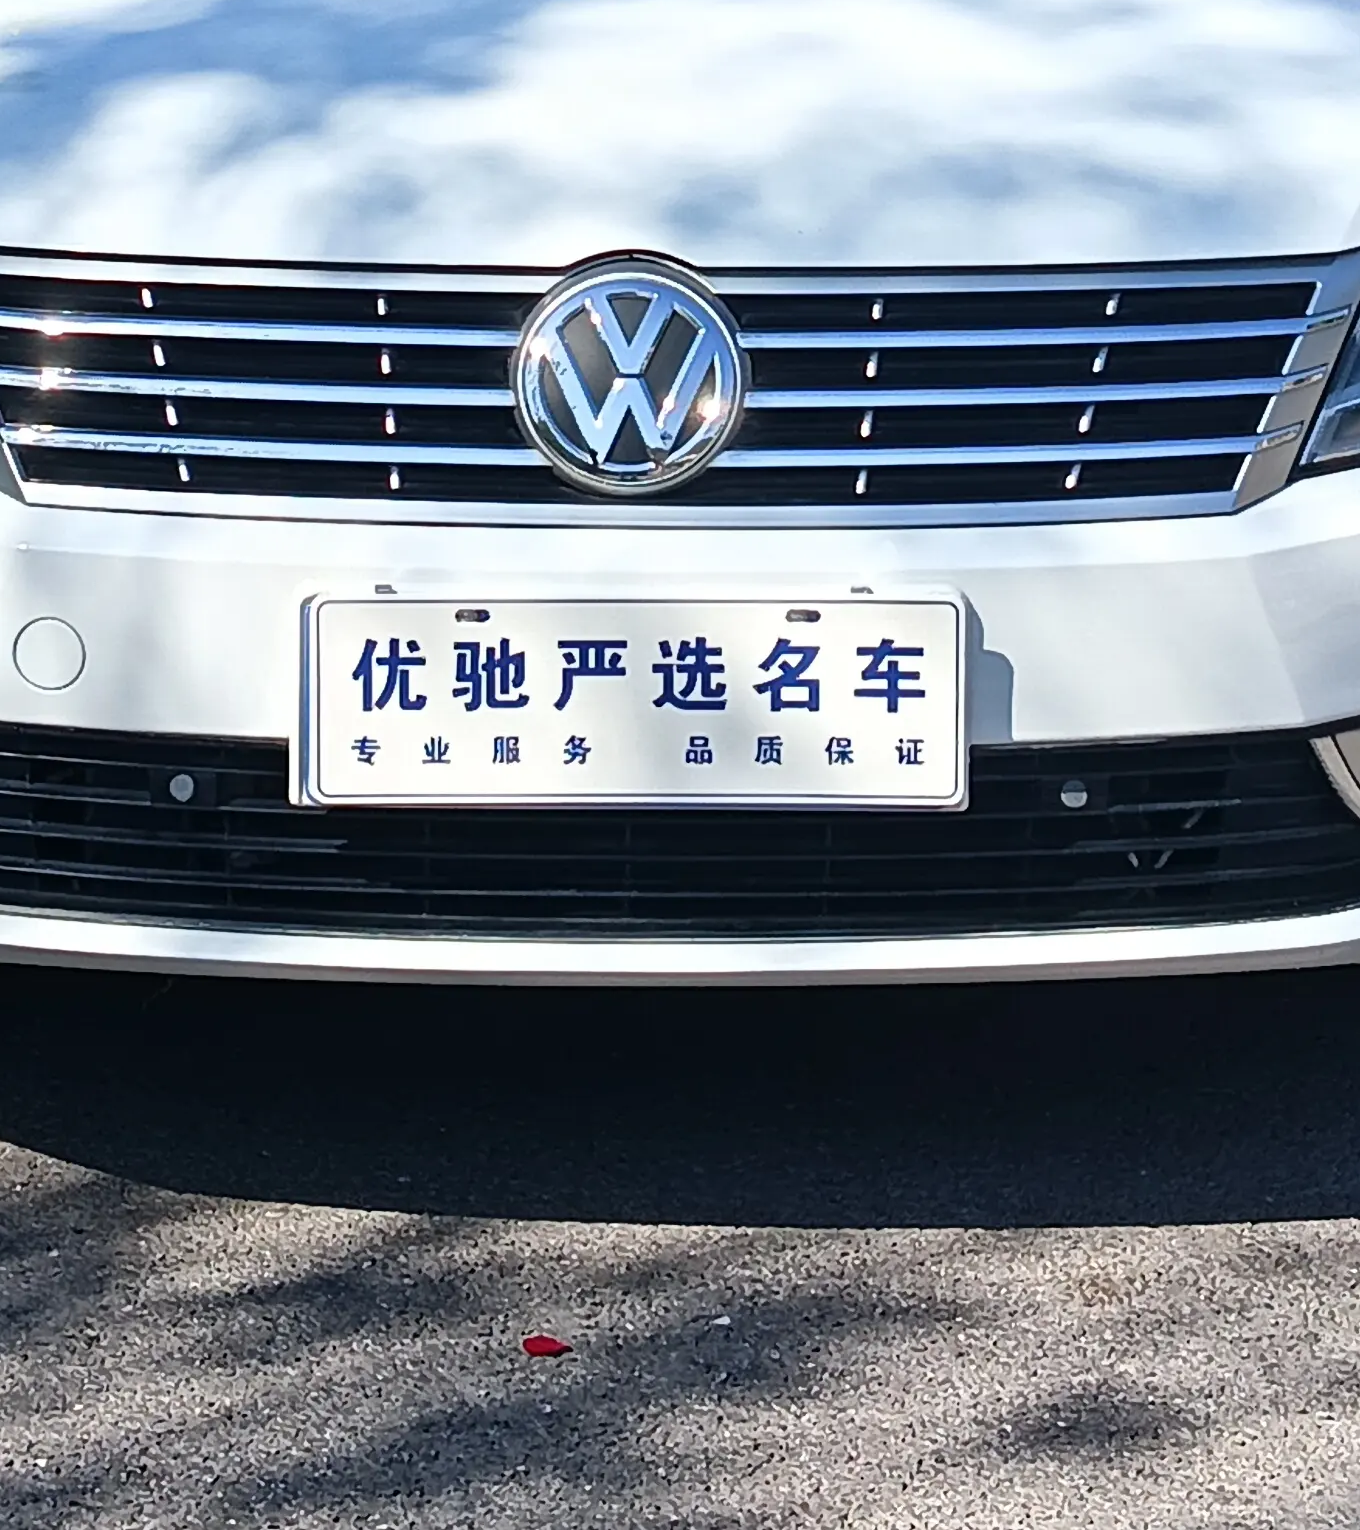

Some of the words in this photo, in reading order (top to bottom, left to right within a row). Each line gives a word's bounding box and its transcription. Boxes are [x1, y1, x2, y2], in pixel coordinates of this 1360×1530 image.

[351, 636, 926, 713] 优驰严选名车
[351, 735, 592, 766] 专业服务
[685, 735, 925, 766] 品质保证
